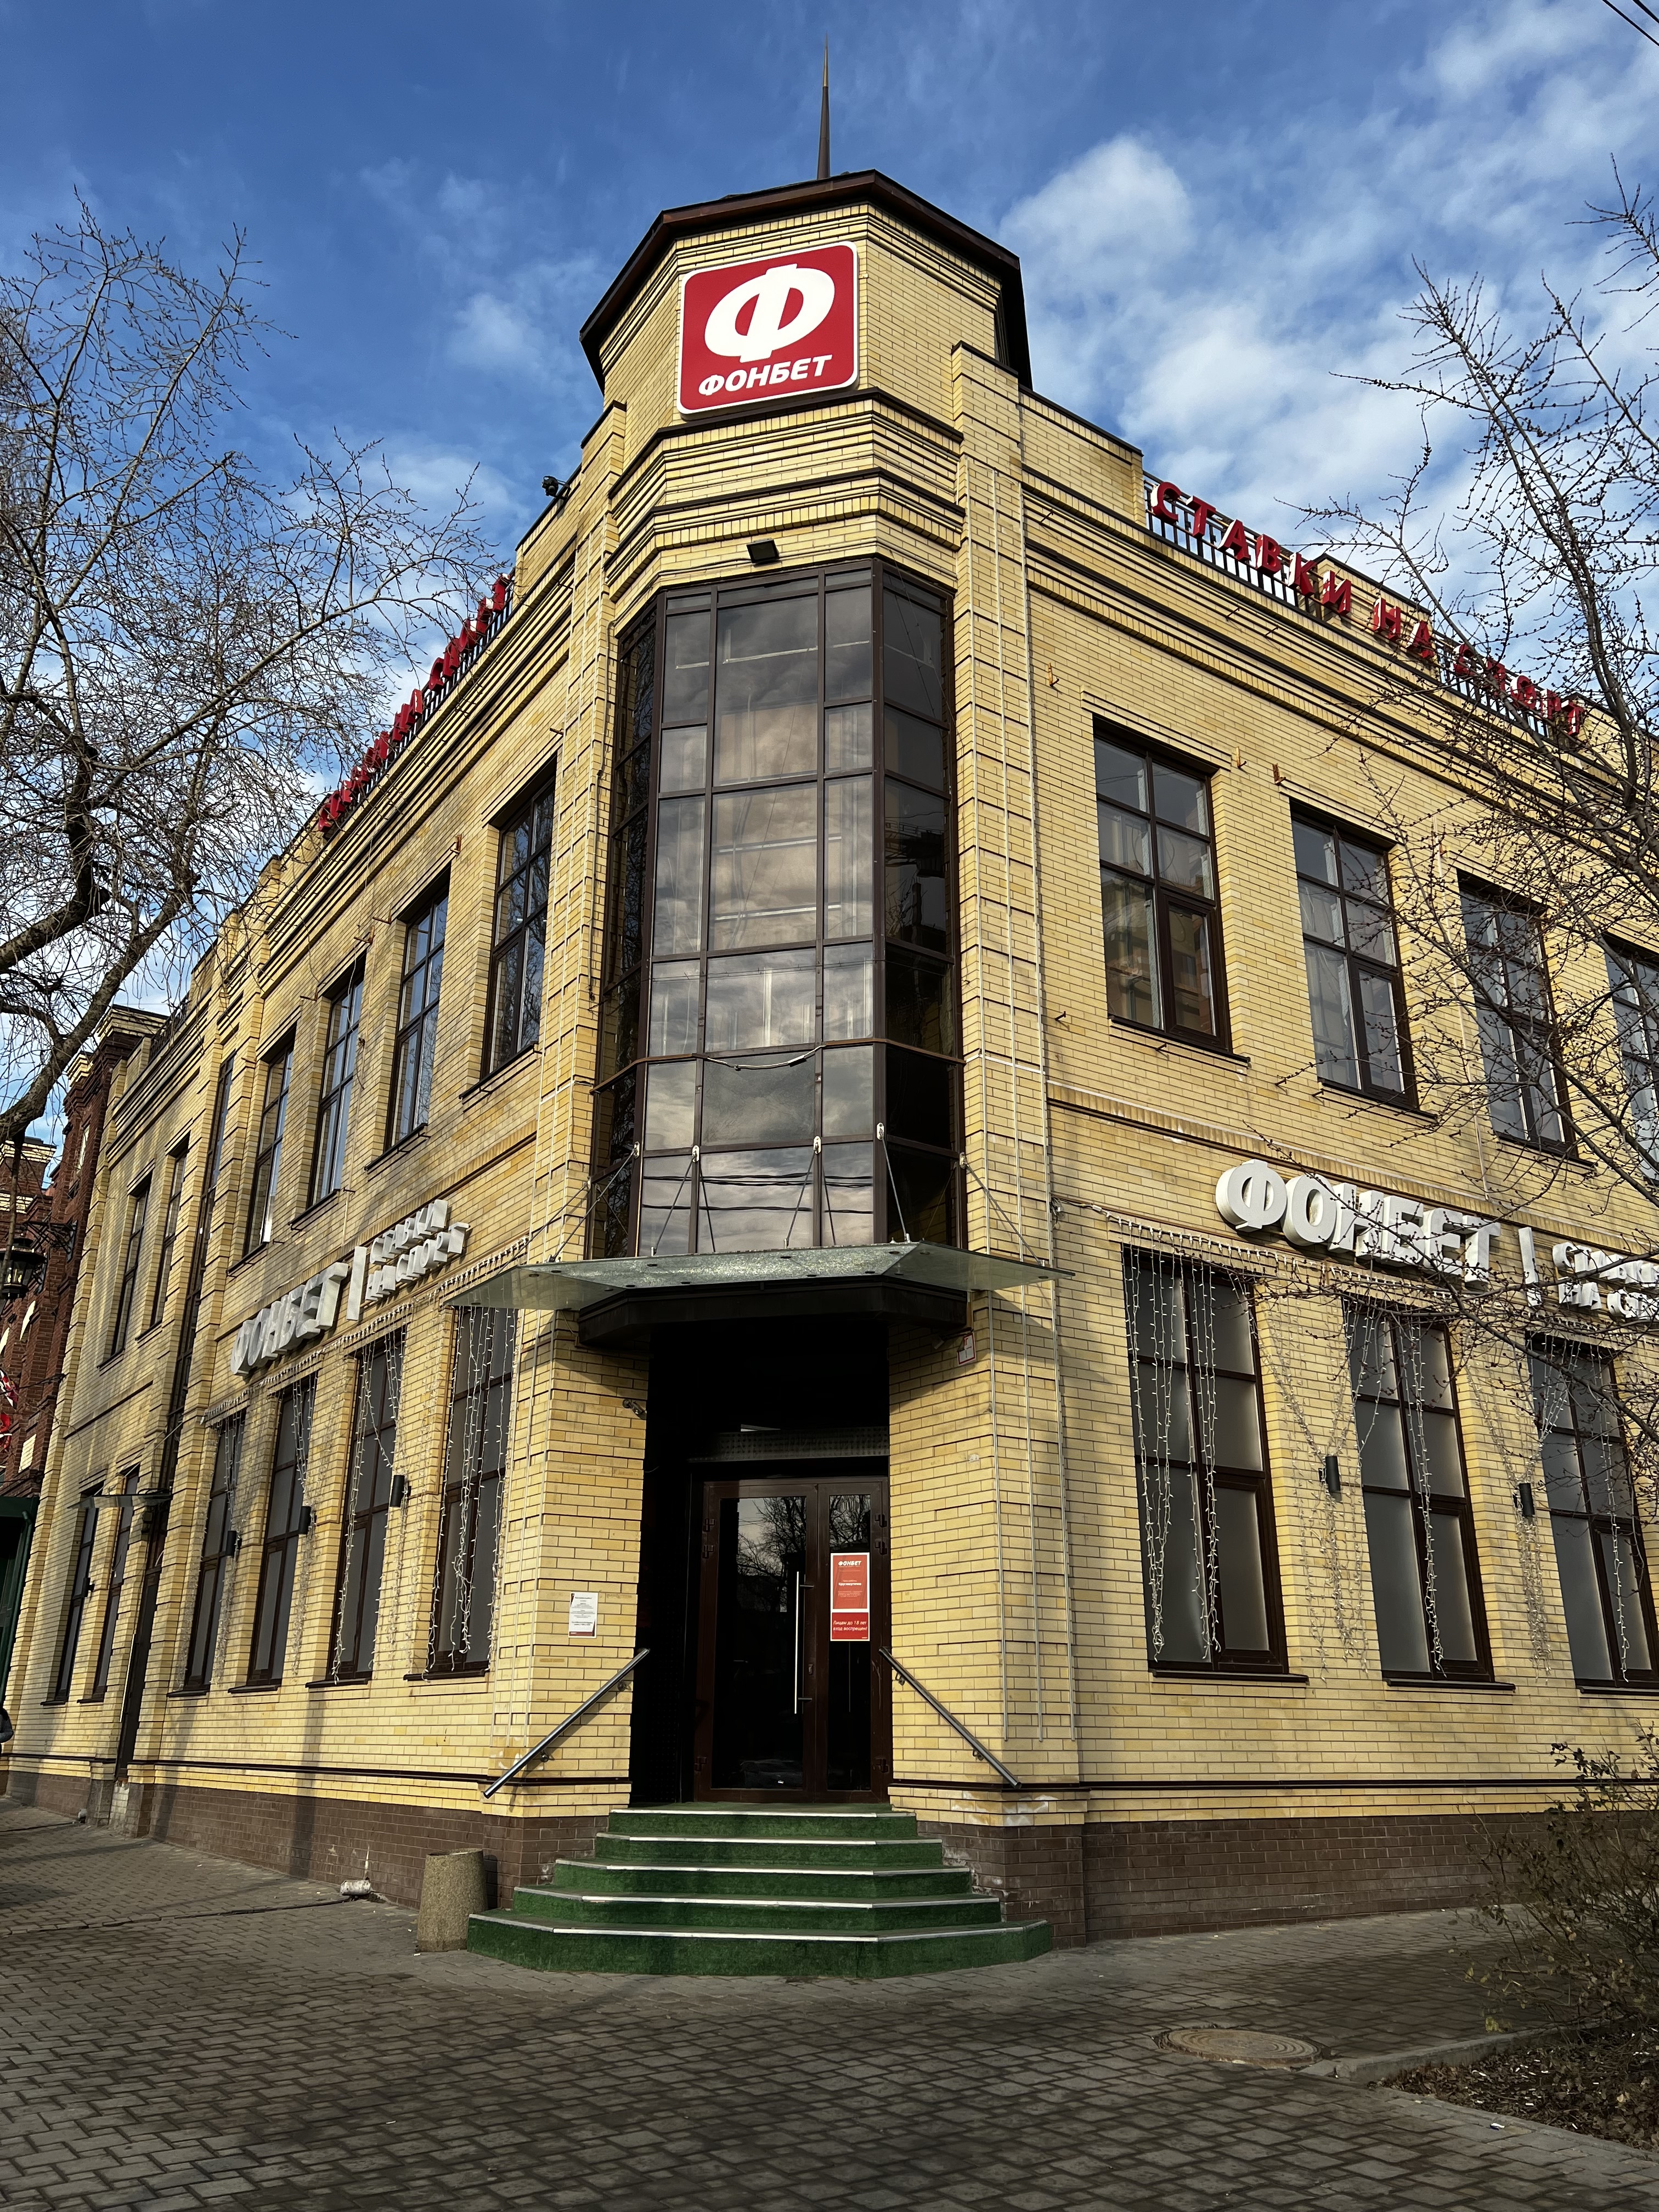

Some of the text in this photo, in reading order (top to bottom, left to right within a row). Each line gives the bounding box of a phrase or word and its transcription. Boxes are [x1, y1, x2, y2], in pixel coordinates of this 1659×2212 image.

[704, 263, 835, 363] Ф
[698, 354, 832, 396] ФОНБЕТ
[1151, 481, 1352, 616] СТАВКИ
[1373, 597, 1435, 658] НА
[365, 1222, 470, 1301] НА СПОРТ
[370, 1199, 448, 1265] СТАВКИ
[1216, 1159, 1502, 1285] ФОНБЕТ
[230, 1262, 348, 1376] ФОНБЕТ
[1558, 1277, 1602, 1310] НА
